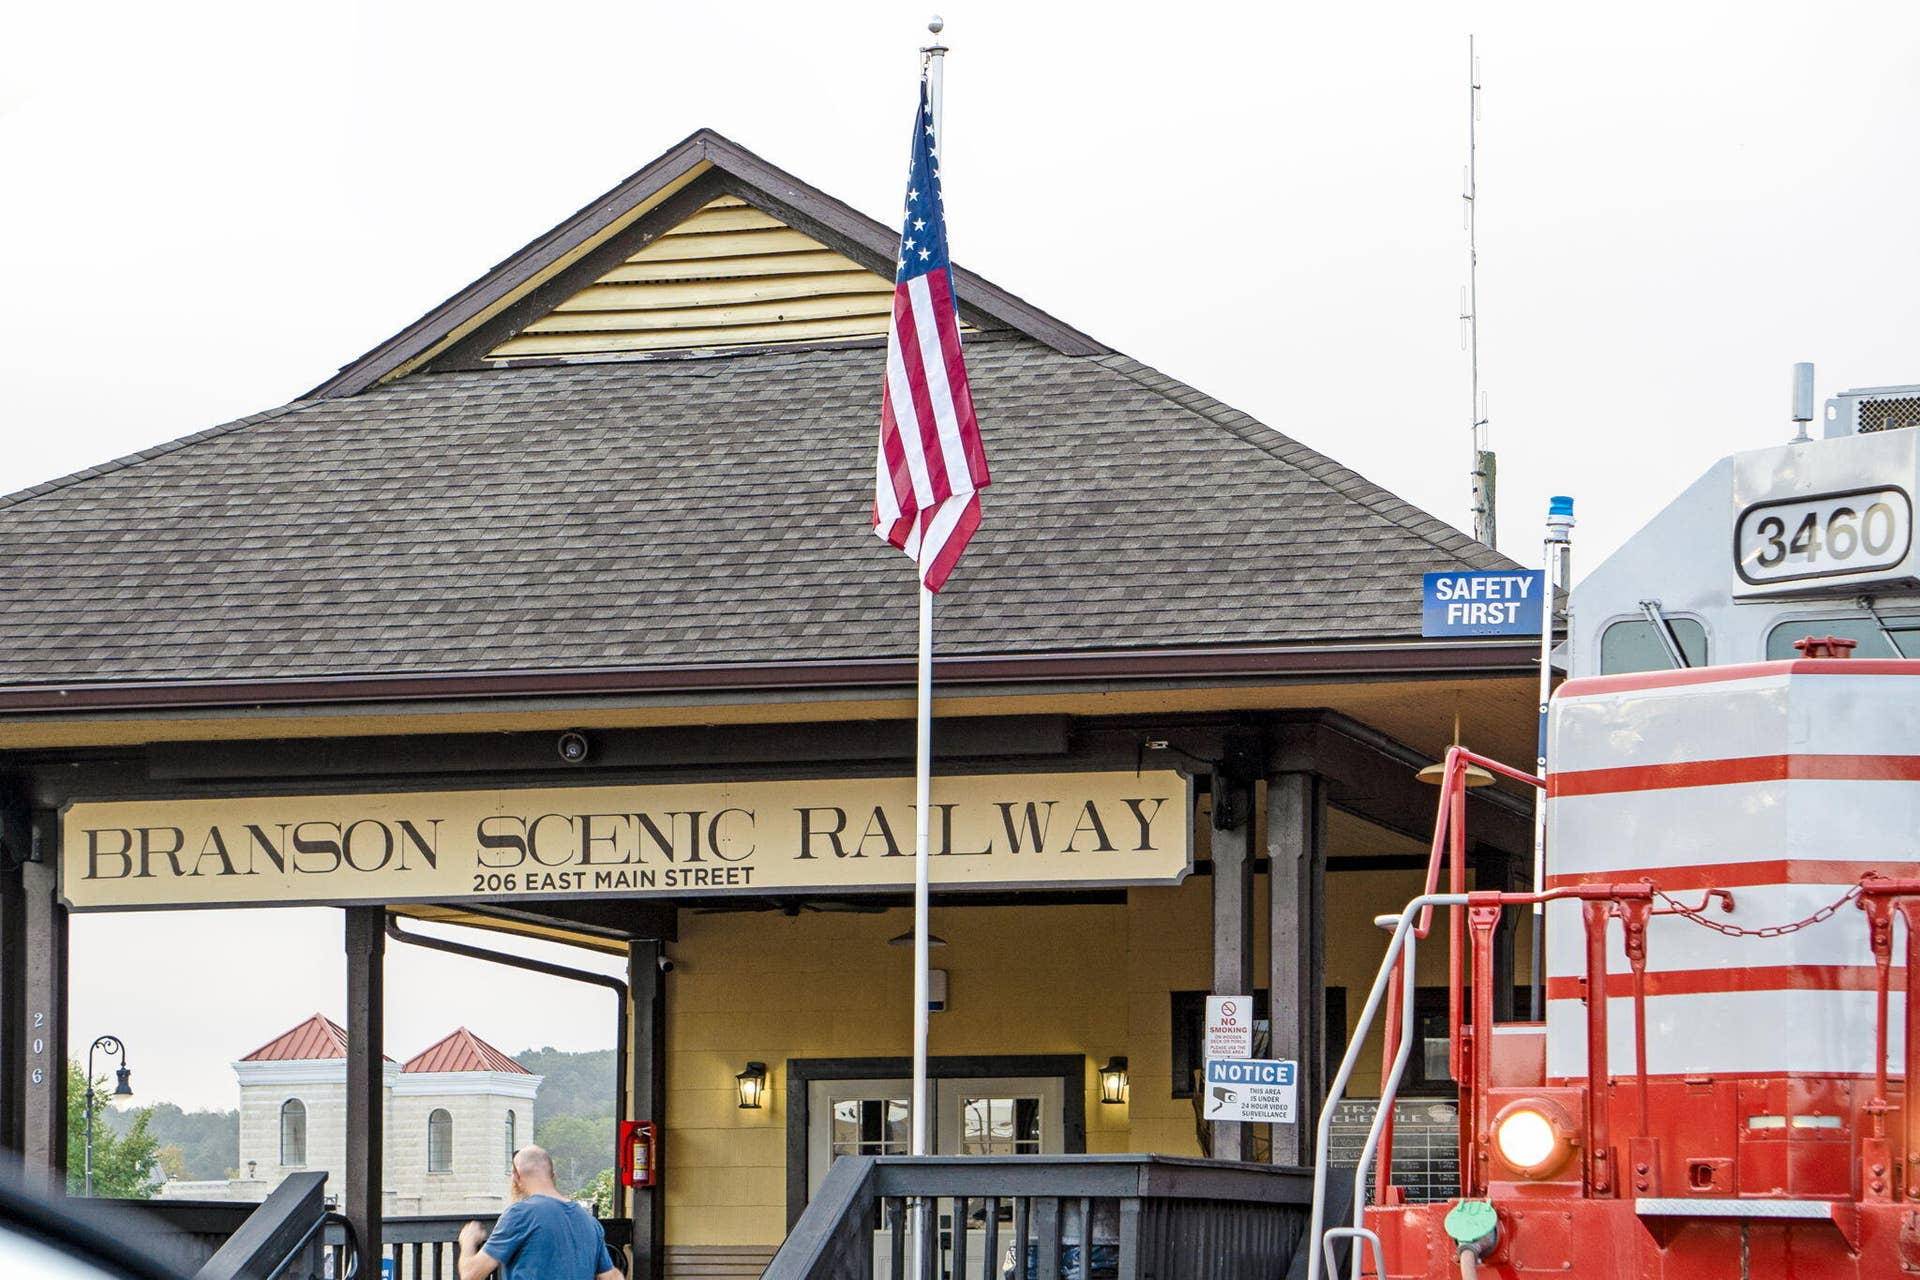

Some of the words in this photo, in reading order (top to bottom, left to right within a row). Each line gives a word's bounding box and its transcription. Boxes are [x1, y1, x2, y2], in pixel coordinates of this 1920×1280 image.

[1756, 502, 1896, 569] 3460
[1435, 576, 1534, 601] SAFETY
[1447, 602, 1520, 625] FIRST
[81, 819, 445, 880] BRANSON
[476, 808, 755, 868] SCENIC
[472, 873, 517, 892] 206
[526, 871, 587, 891] EAST
[595, 869, 656, 889] MAIN
[664, 866, 755, 887] STREET
[1209, 1026, 1248, 1034] SMOKING
[1221, 1018, 1237, 1026] NO
[1214, 1064, 1288, 1083] NOTICE
[1264, 1088, 1281, 1096] AREA
